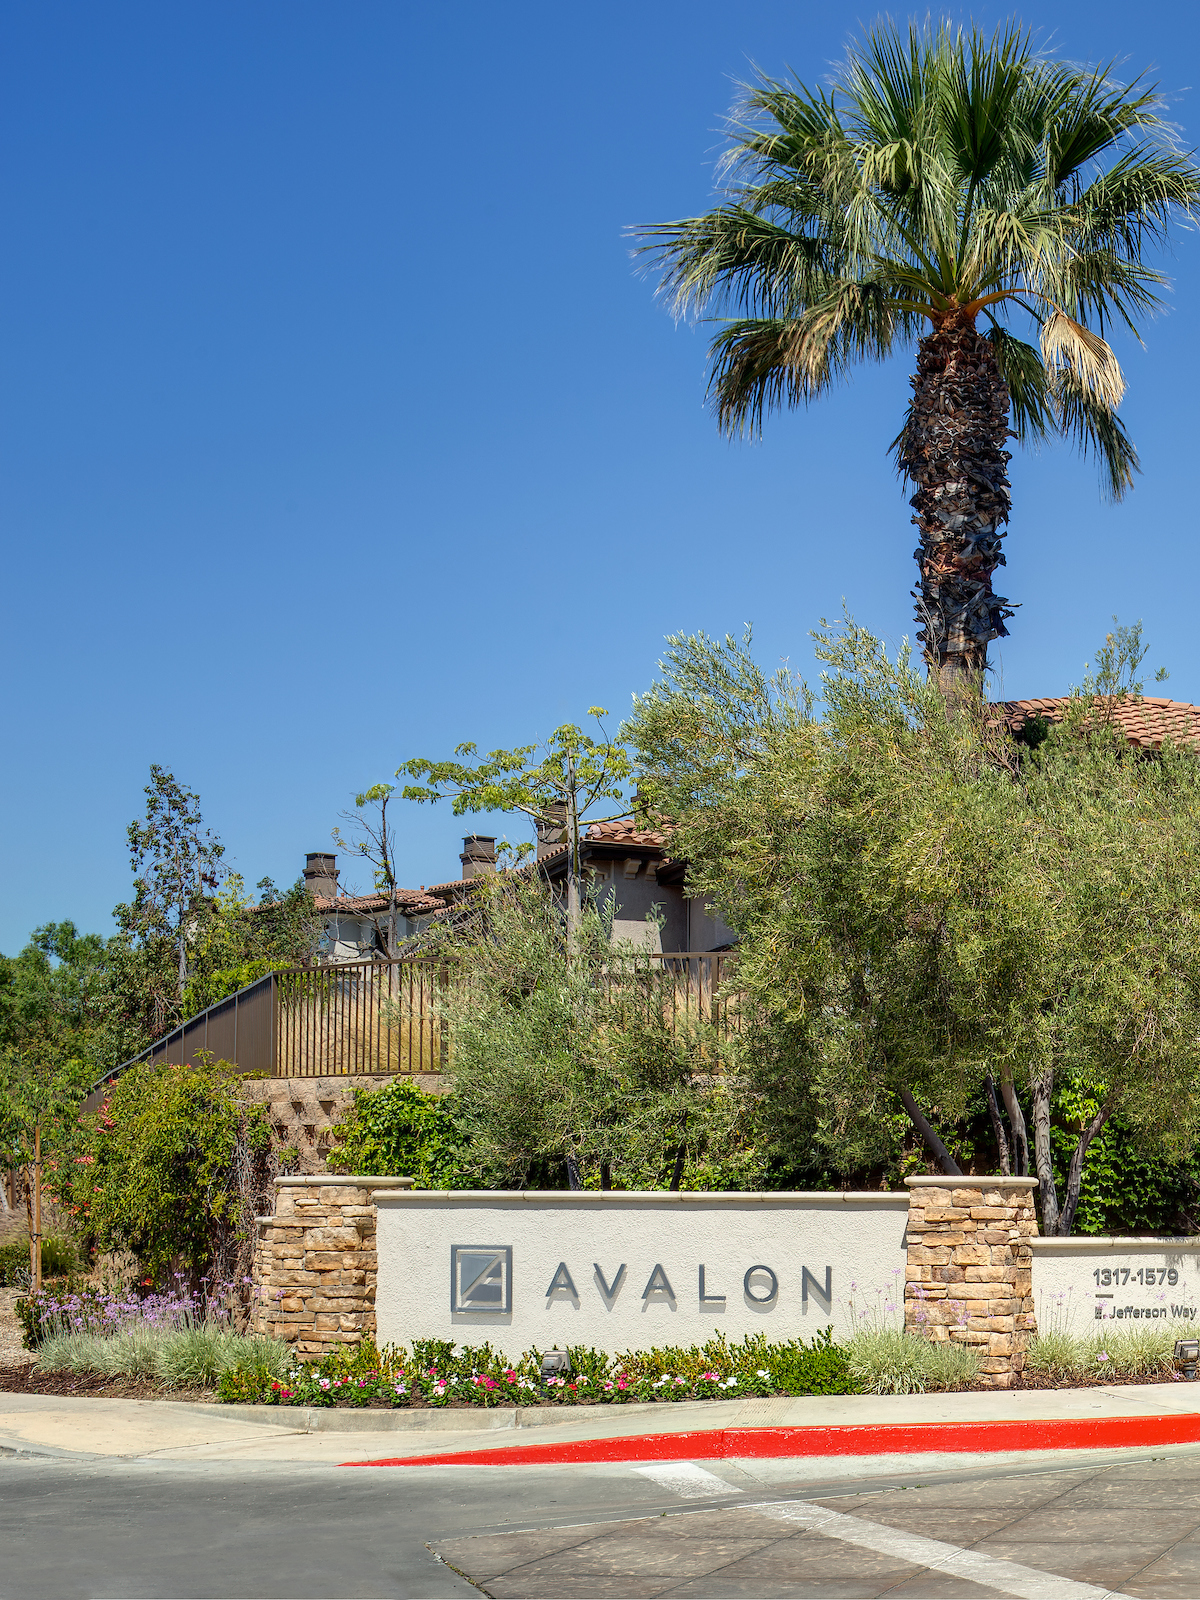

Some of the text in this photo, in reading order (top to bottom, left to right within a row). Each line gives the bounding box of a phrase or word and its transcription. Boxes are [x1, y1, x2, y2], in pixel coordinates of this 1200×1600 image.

[545, 1262, 832, 1303] AVALON
[1093, 1268, 1179, 1286] 1317-1579
[1095, 1305, 1197, 1320] E. Jefferson Way
